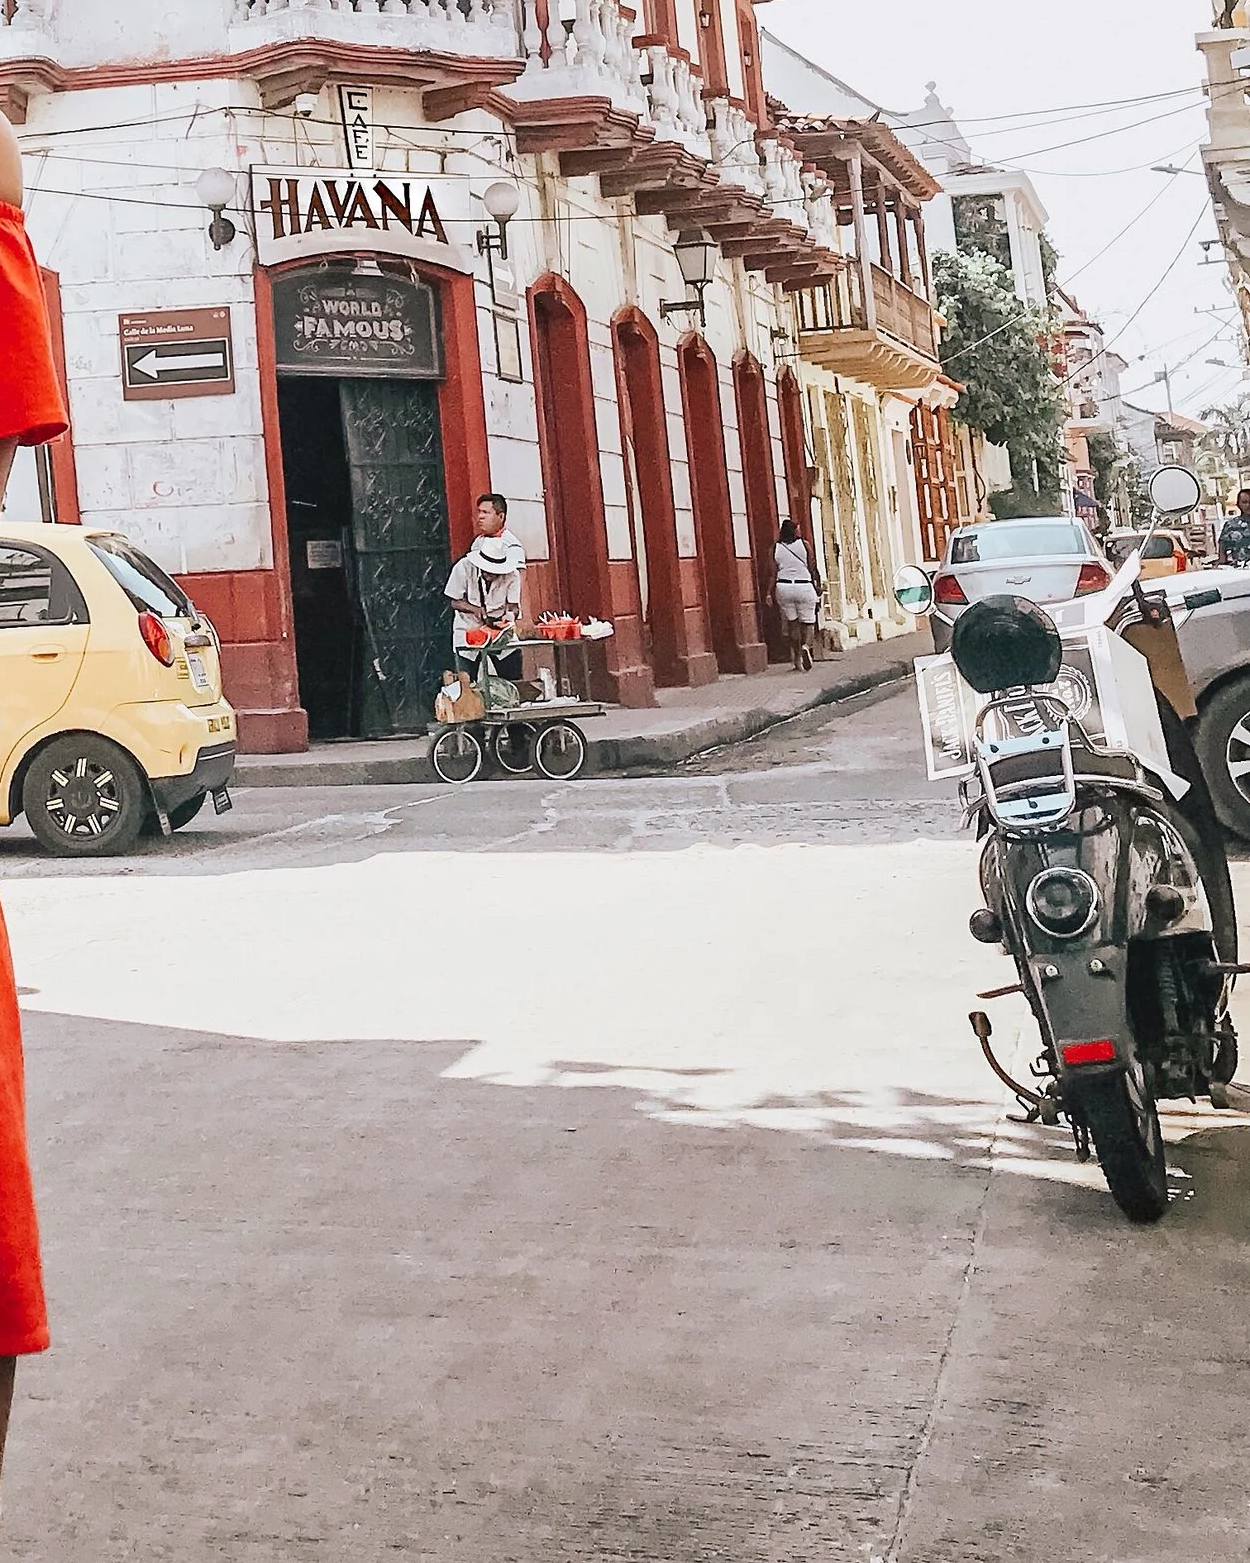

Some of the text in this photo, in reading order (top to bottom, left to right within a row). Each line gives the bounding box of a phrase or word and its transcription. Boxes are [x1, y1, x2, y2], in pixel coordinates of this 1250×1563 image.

[260, 177, 449, 245] HAVANA
[321, 299, 382, 317] WORLD
[303, 316, 404, 341] FAMOUS
